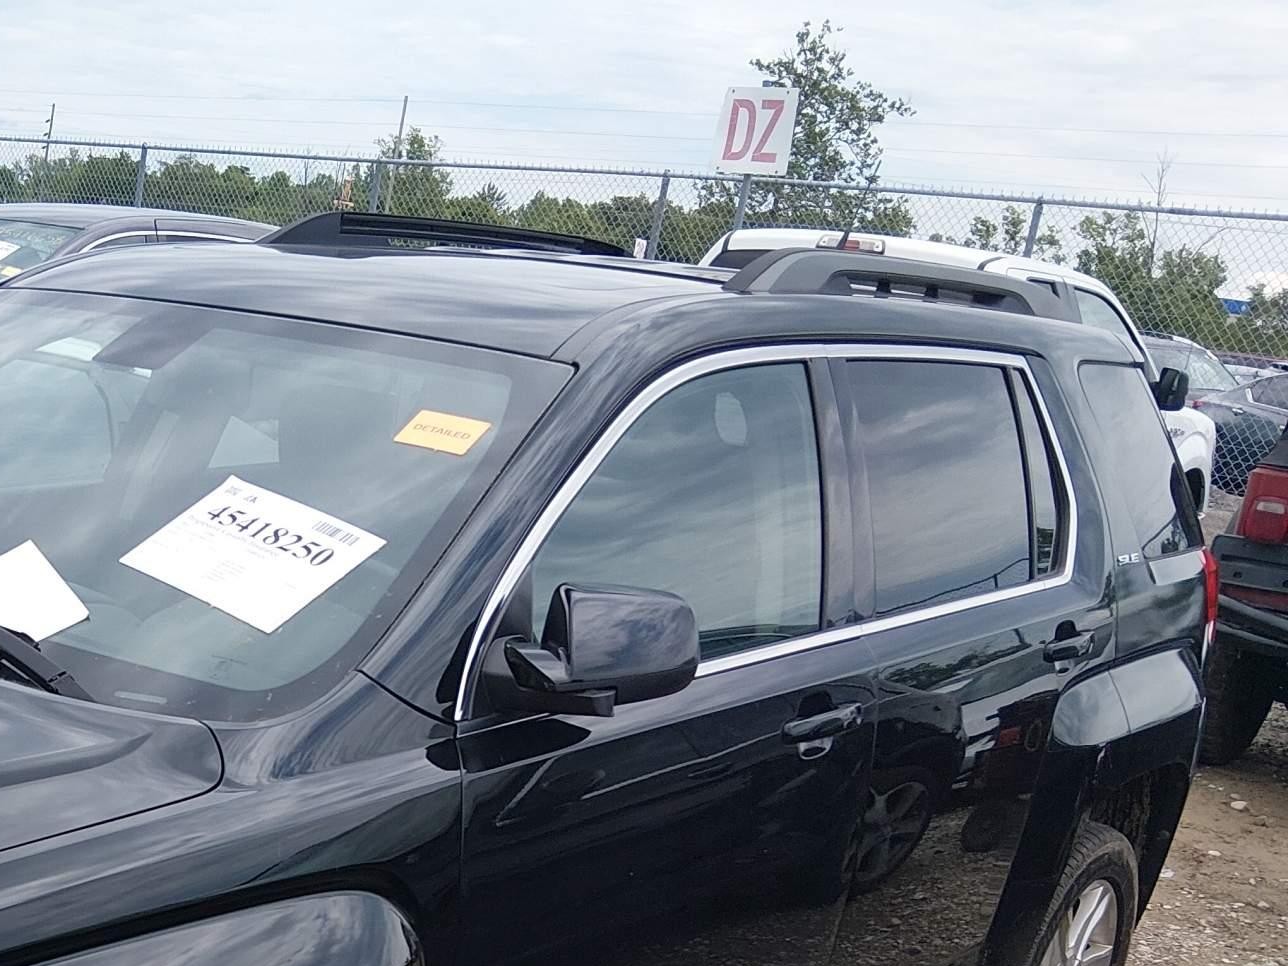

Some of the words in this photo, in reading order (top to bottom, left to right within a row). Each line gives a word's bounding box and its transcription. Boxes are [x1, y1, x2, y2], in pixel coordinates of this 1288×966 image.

[721, 98, 785, 163] DZ
[413, 423, 471, 440] DETAILED
[207, 505, 335, 567] 45418250
